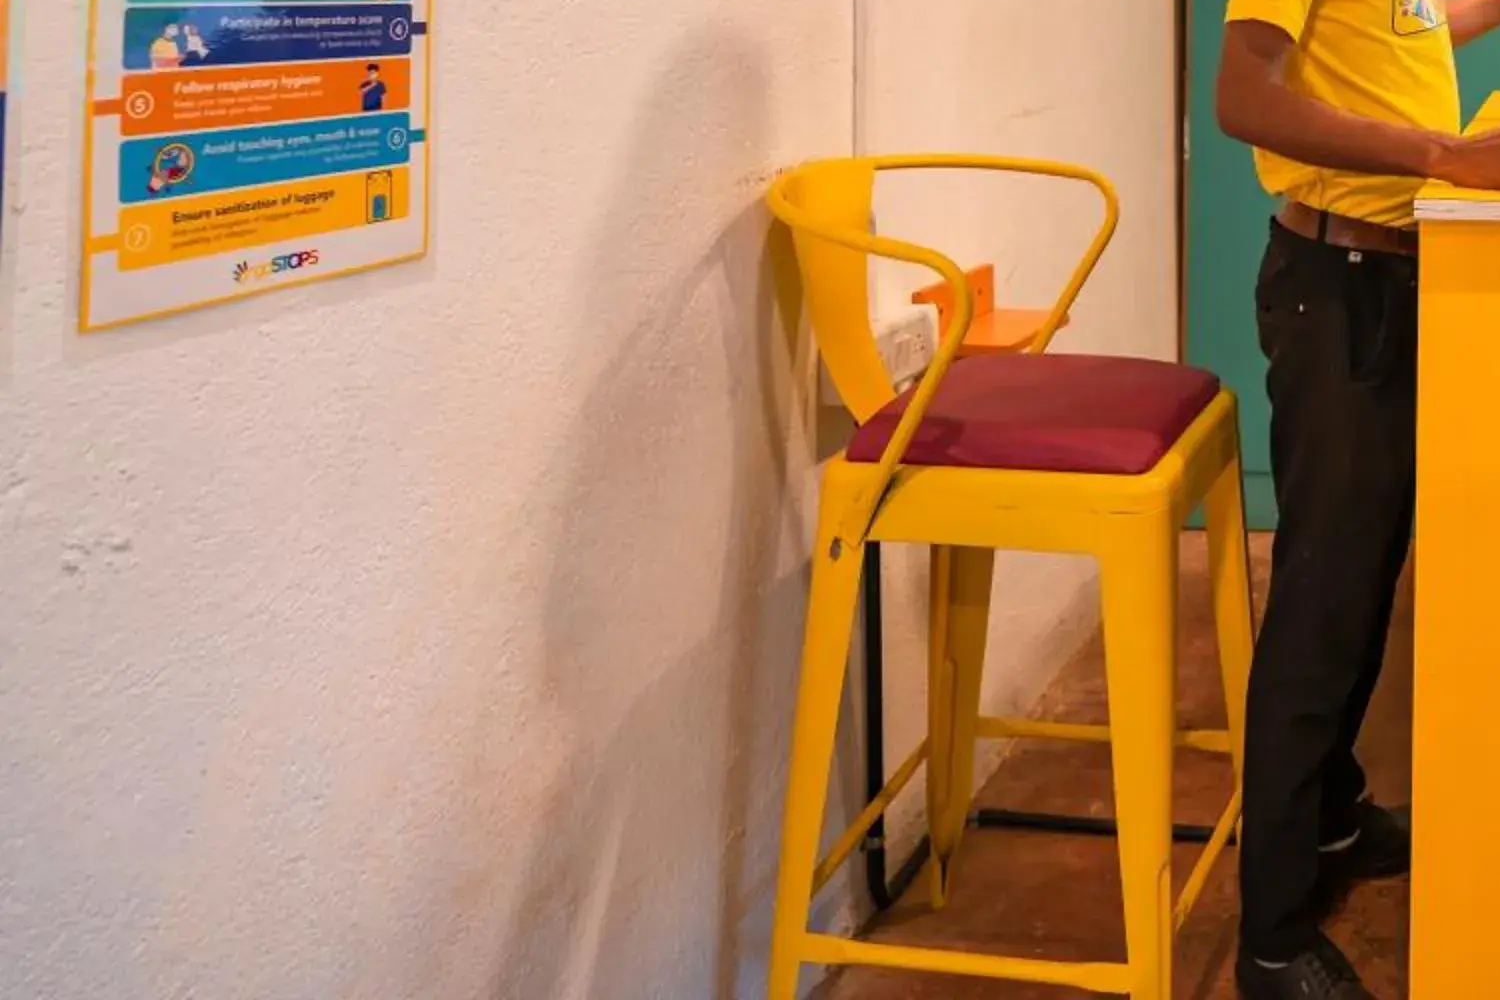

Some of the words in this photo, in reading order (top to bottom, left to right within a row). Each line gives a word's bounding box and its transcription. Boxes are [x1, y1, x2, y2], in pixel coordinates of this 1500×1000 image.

[220, 15, 280, 30] Participate
[283, 16, 293, 27] in
[295, 14, 356, 28] temperature
[173, 80, 214, 95] Follow
[217, 77, 279, 94] respiratory
[202, 139, 236, 156] Avoid
[238, 136, 286, 151] touching
[315, 128, 346, 141] mouth
[172, 207, 212, 224] Ensure
[215, 196, 279, 217] sanitization
[281, 194, 291, 206] of
[294, 188, 335, 206] luggage
